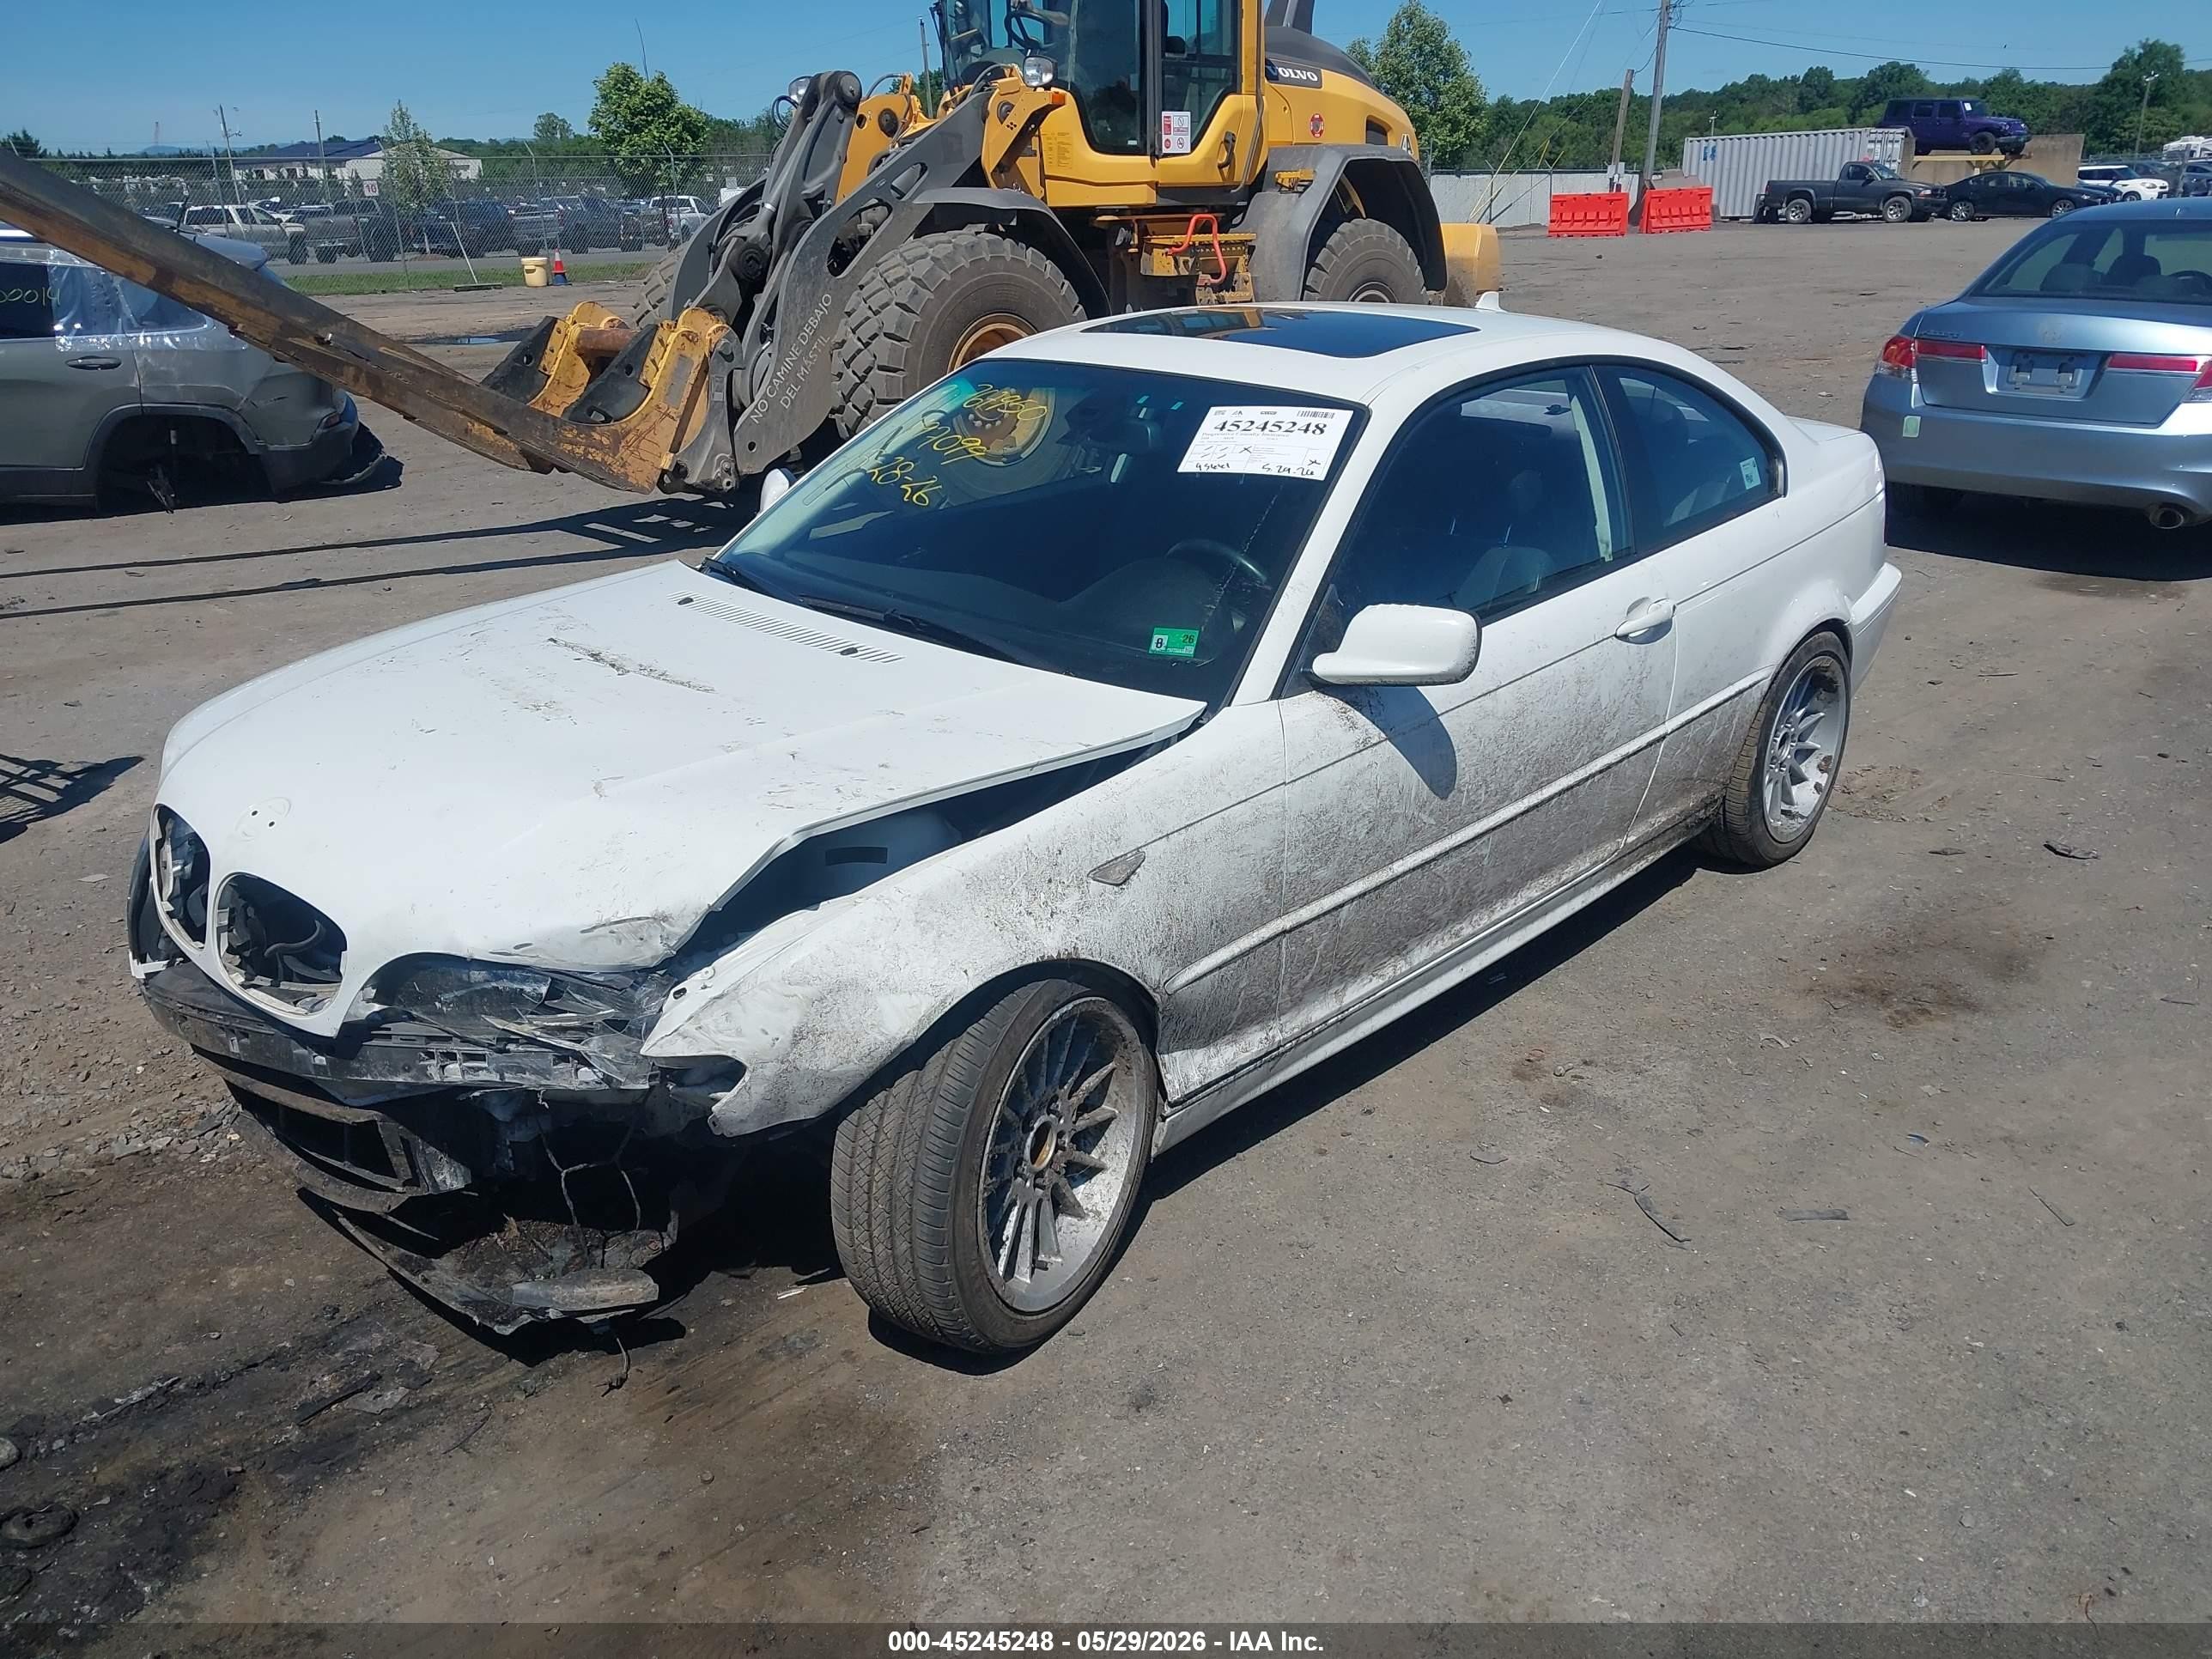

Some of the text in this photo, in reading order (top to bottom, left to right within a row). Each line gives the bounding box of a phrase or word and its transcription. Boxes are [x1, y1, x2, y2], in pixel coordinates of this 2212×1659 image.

[1266, 65, 1318, 82] VOLVO
[750, 294, 832, 424] NO CAMINE DEBAJO
[780, 335, 830, 410] DEL MÁSTIL
[1214, 420, 1328, 435] 45245248
[1155, 637, 1164, 648] 8
[1182, 634, 1195, 644] 26
